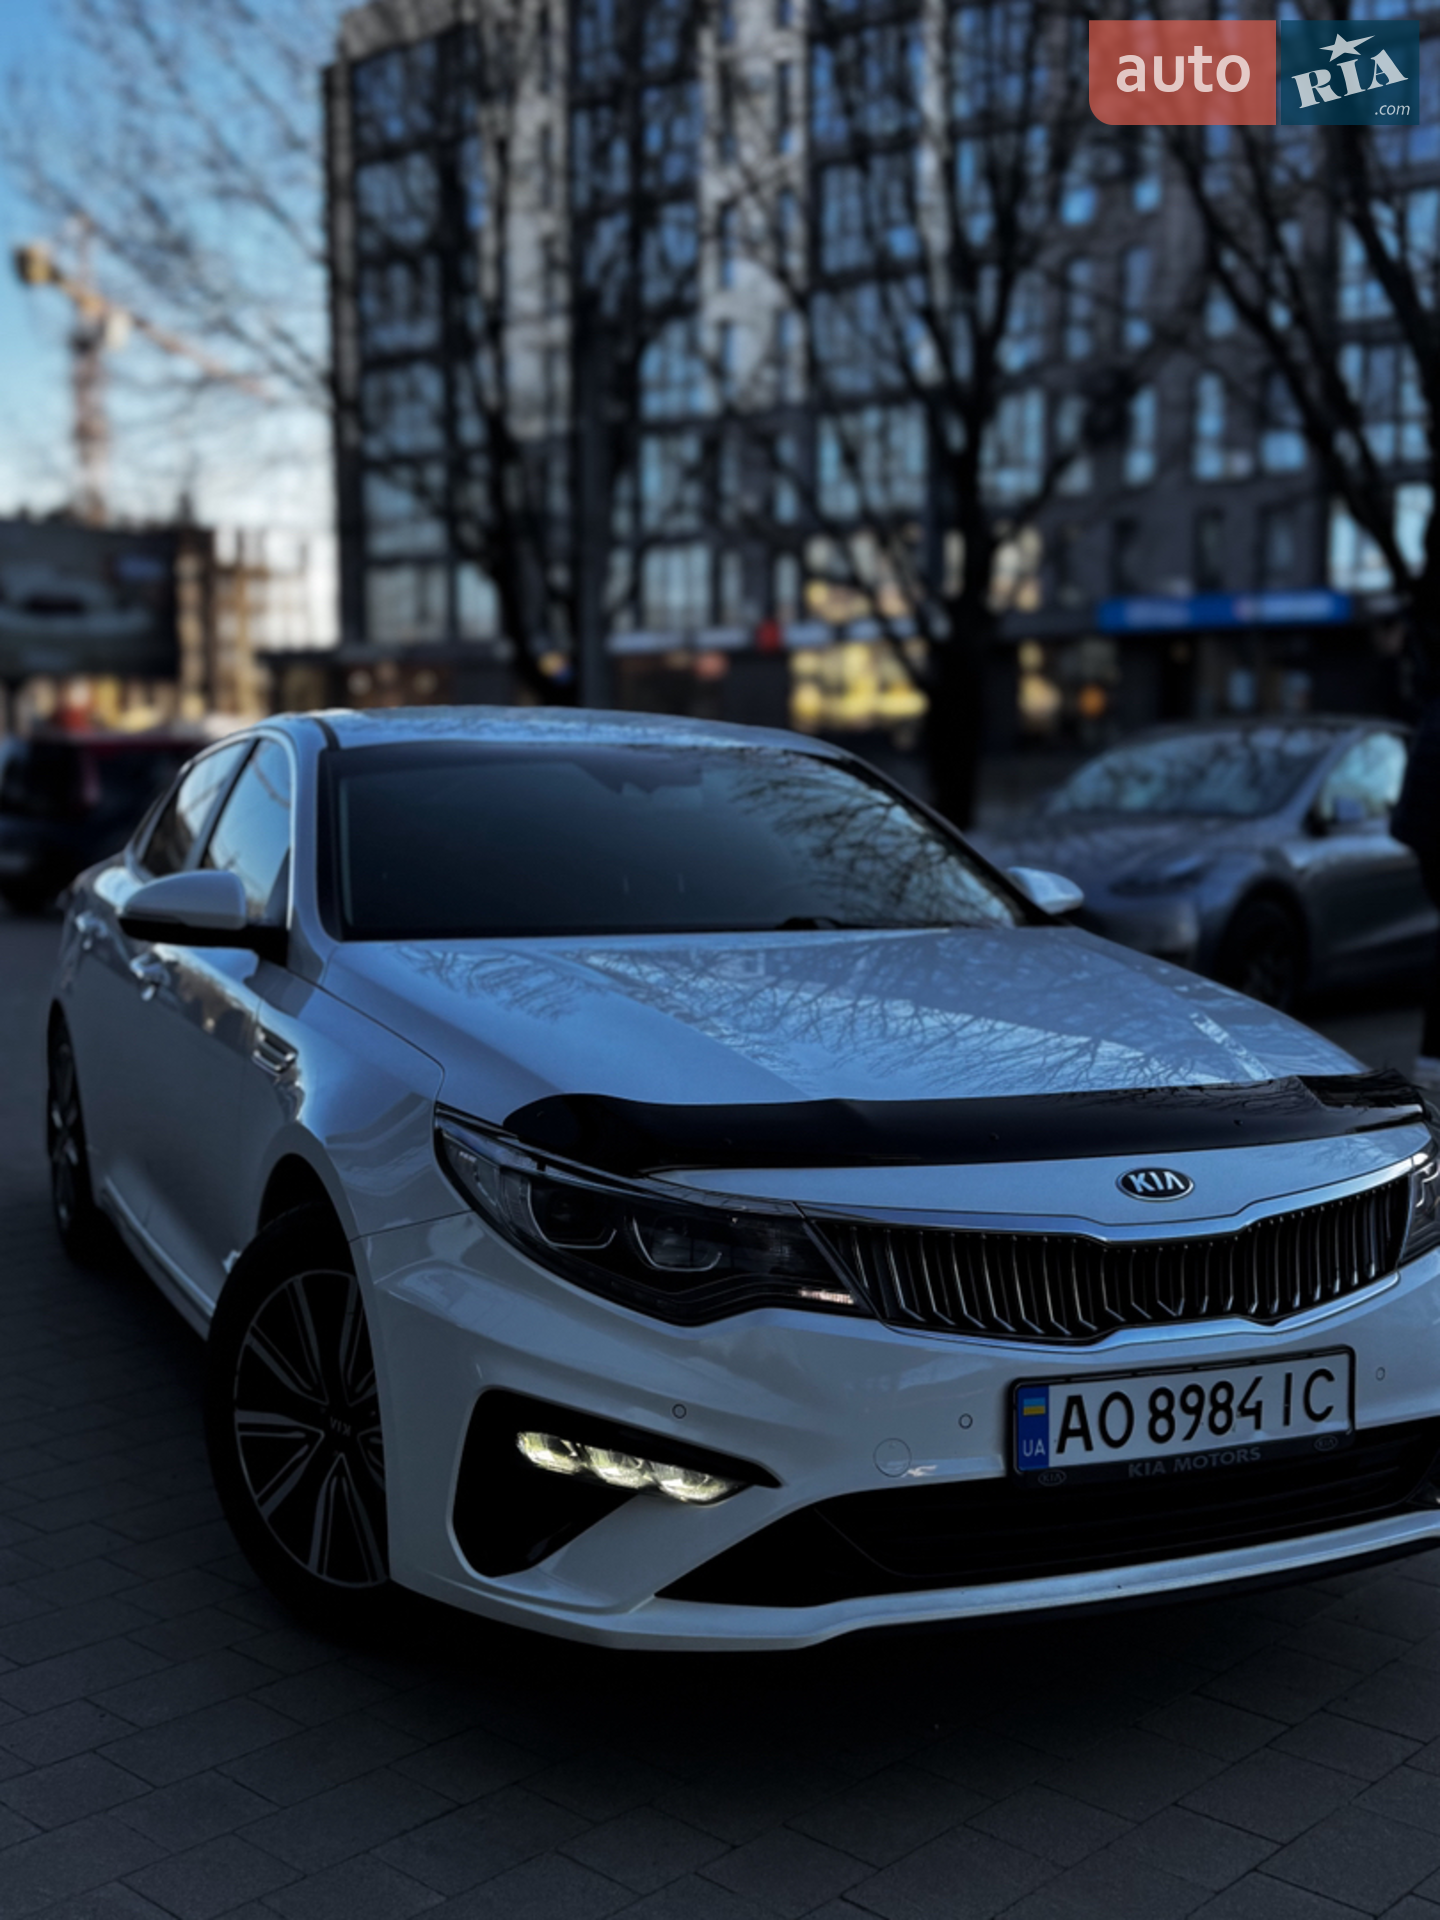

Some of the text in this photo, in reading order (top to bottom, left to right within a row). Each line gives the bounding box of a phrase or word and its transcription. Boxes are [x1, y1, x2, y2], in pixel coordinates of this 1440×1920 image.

[1128, 1171, 1186, 1193] KIA
[1056, 1368, 1335, 1454] AO 8984 IC
[1022, 1438, 1046, 1457] UA
[1127, 1446, 1262, 1479] KIA MOTORS
